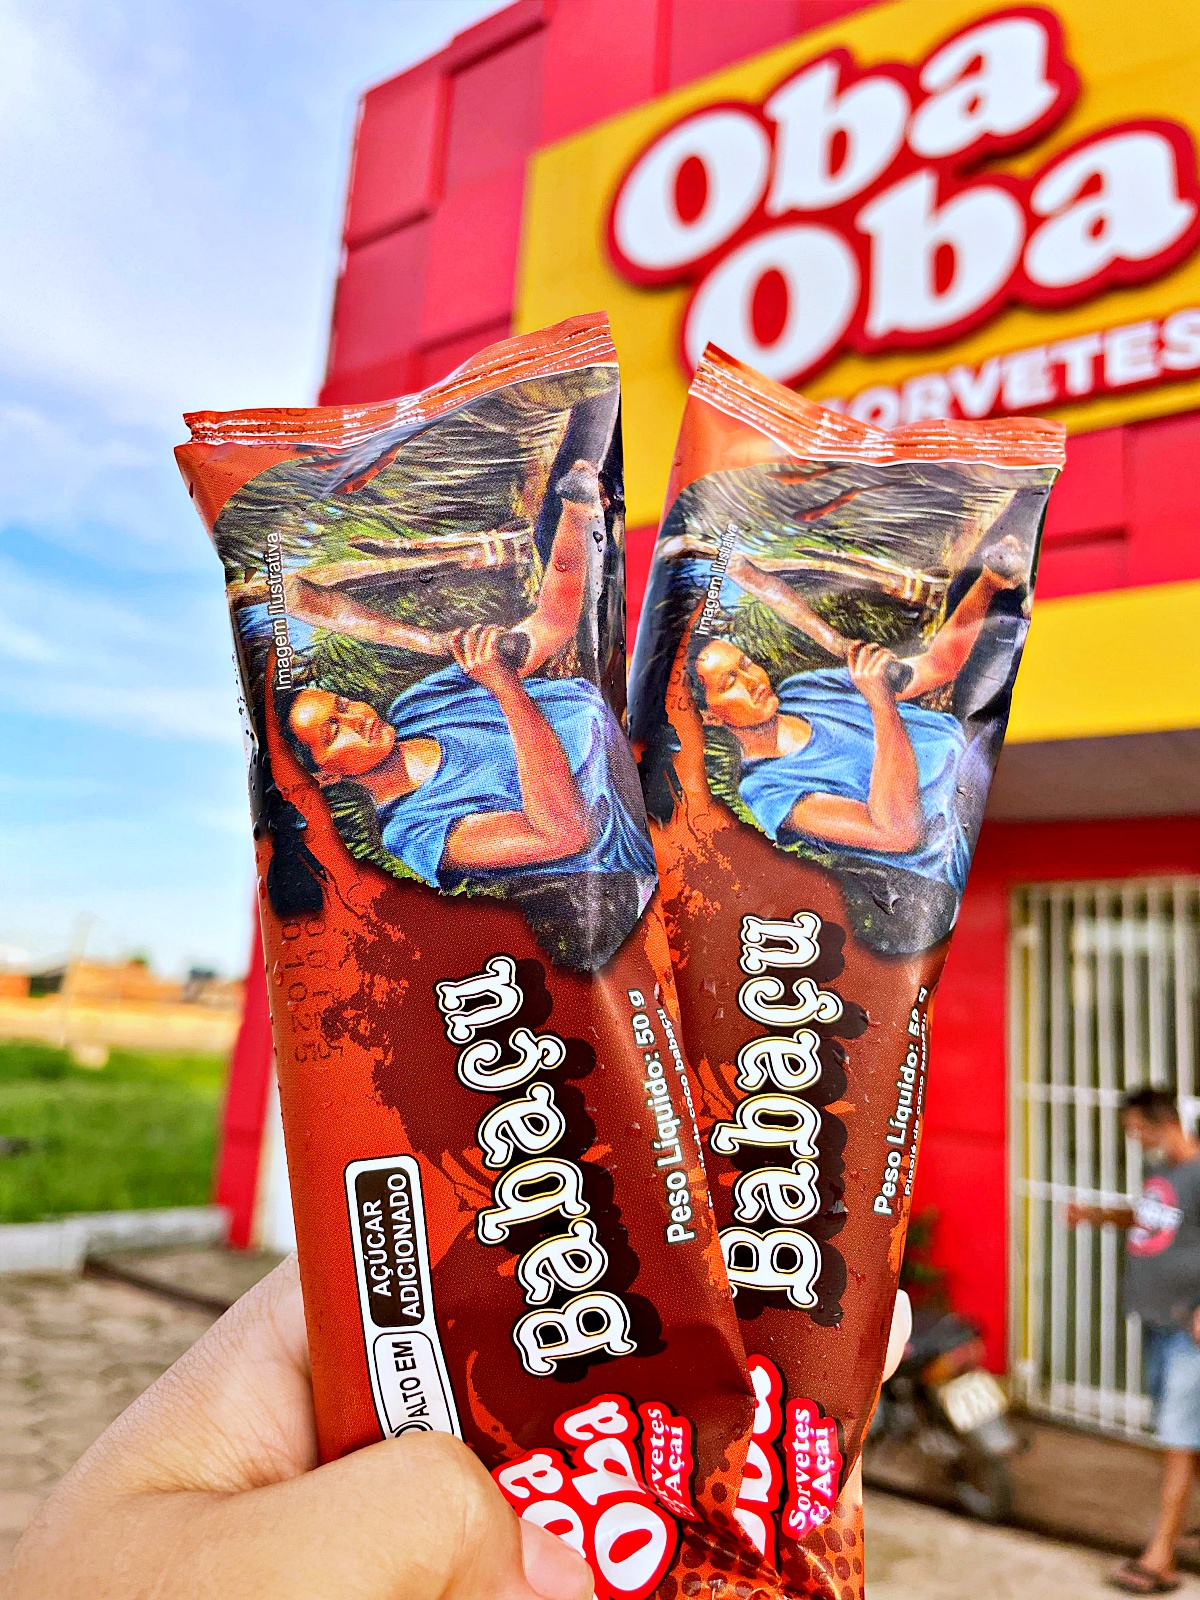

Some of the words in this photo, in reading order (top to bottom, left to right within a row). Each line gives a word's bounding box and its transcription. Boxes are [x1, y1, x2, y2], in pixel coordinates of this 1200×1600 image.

[612, 15, 1061, 272] Oba
[683, 129, 1198, 385] Oba
[822, 307, 1200, 427] ORVETES
[275, 617, 294, 691] Imagem
[694, 575, 724, 636] Imagem
[627, 988, 645, 1008] g
[631, 1012, 656, 1047] 50
[643, 1050, 683, 1169] Líquido:
[710, 911, 844, 1309] Babaçu
[886, 1042, 921, 1146] Líquido:
[437, 955, 638, 1377] Babaçu
[665, 1170, 696, 1244] Peso
[872, 1150, 902, 1216] Peso
[362, 1199, 392, 1298] AÇÚCAR
[386, 1172, 422, 1320] ADICIONADO
[391, 1339, 419, 1374] EM
[398, 1375, 430, 1419] ALTO
[562, 1399, 669, 1593] Oba
[664, 1424, 686, 1497] Açaí
[789, 1408, 811, 1530] Sorvetes
[810, 1427, 836, 1497] Açaí
